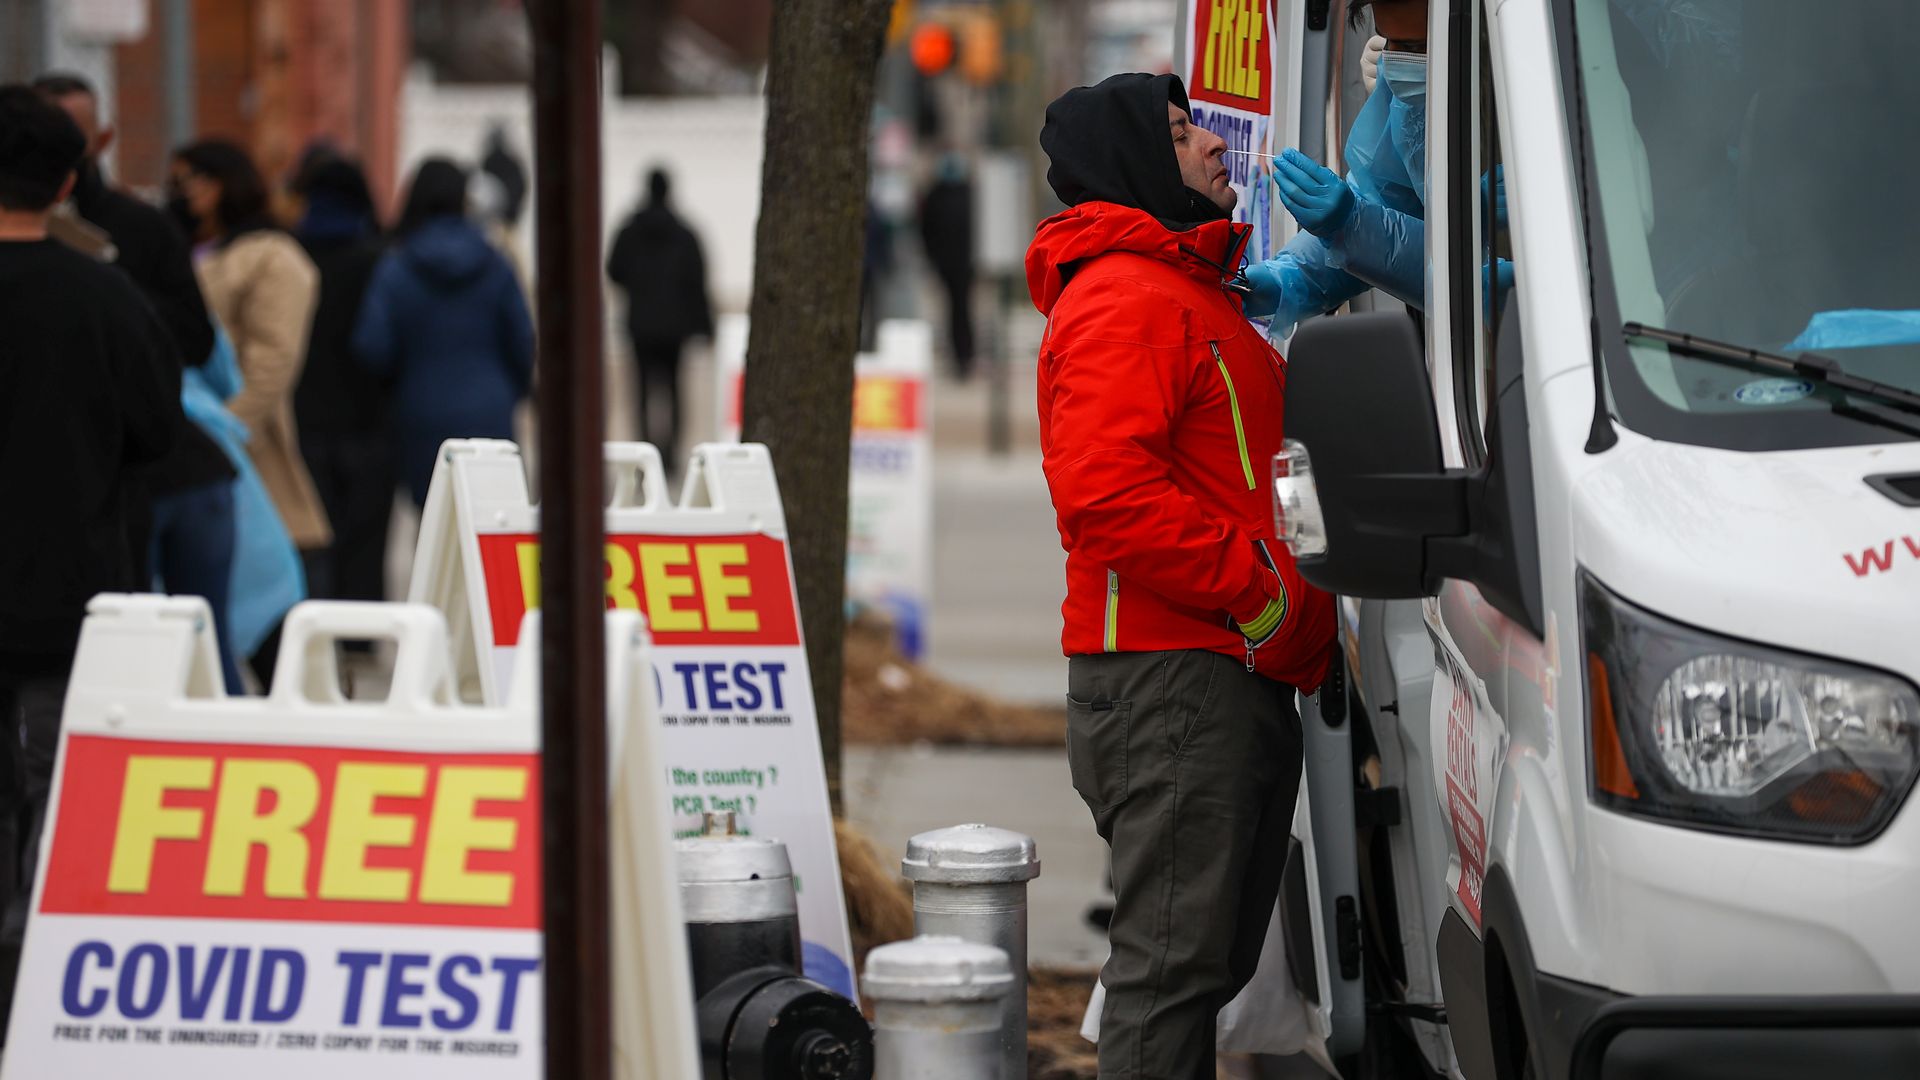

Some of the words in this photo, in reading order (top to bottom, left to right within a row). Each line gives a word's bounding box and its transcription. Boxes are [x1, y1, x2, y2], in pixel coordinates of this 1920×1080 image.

[673, 662, 786, 711] TEST
[672, 767, 698, 785] the
[702, 767, 764, 789] country
[672, 795, 703, 814] PCR
[107, 756, 528, 906] FREE
[61, 940, 307, 1024] COVID
[336, 951, 542, 1033] TEST
[98, 1025, 130, 1043] FOR
[135, 1027, 163, 1044] THE
[379, 1037, 410, 1053] FOR
